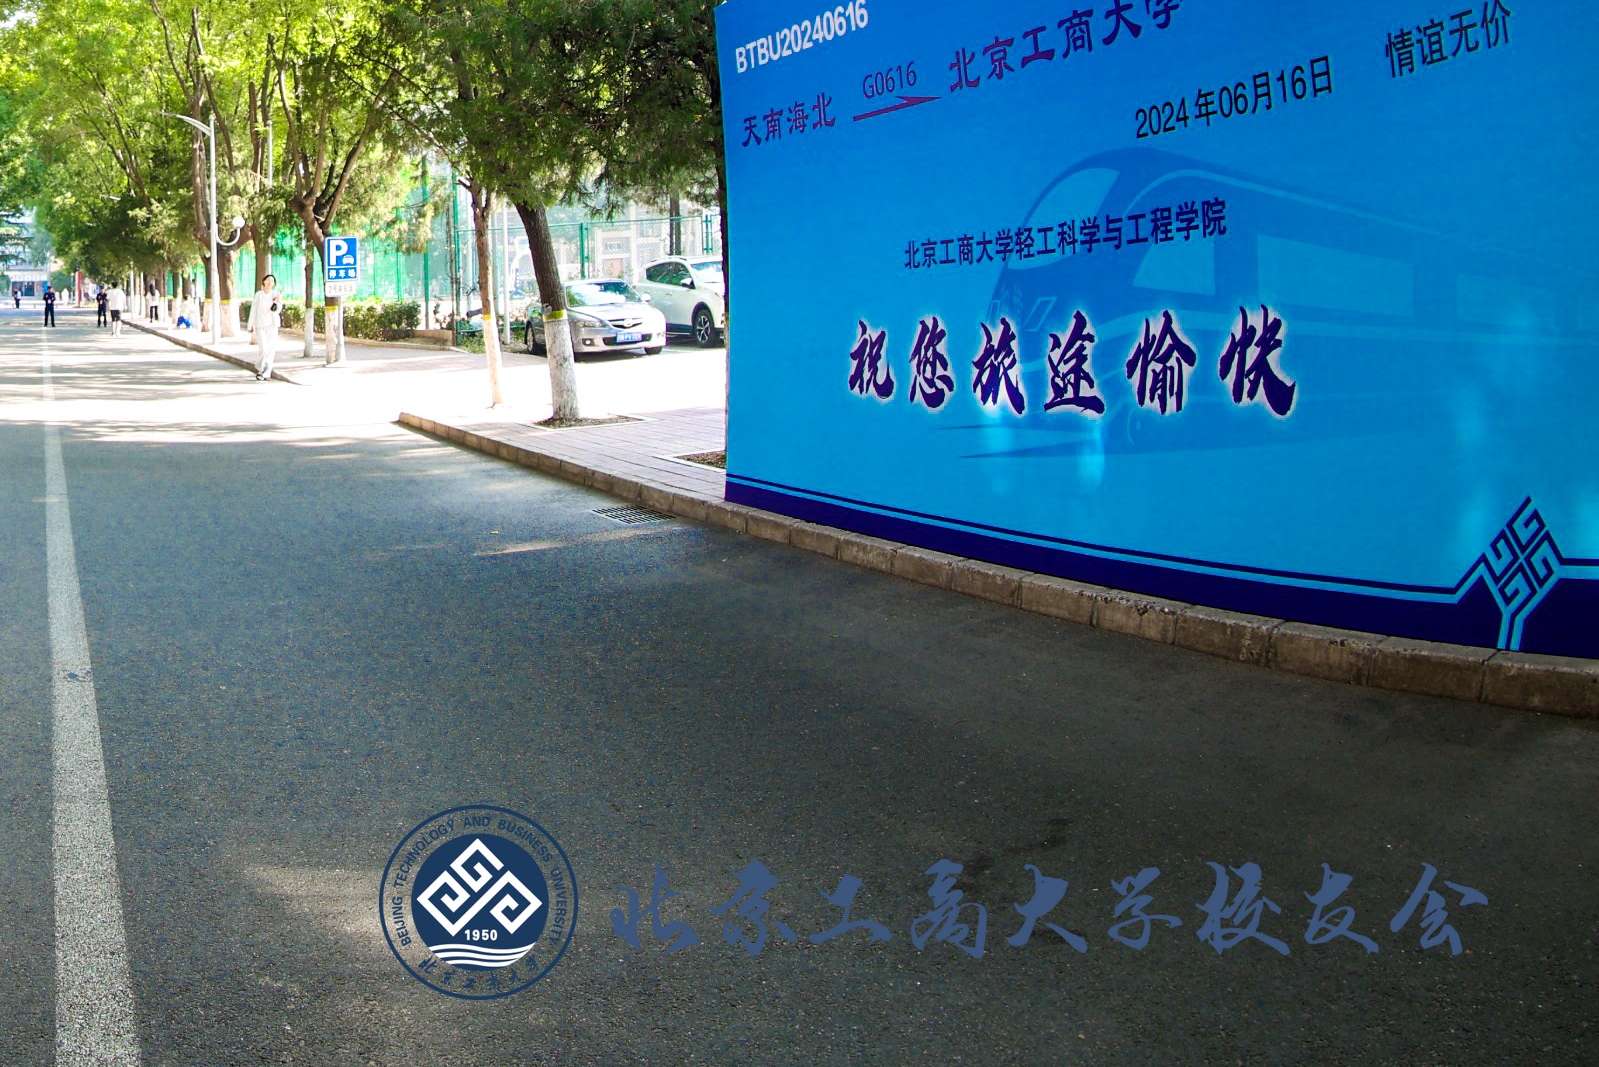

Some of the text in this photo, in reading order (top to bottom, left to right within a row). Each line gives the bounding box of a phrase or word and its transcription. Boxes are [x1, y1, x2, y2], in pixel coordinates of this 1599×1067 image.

[862, 60, 918, 100] G0616
[741, 91, 836, 147] 天南海北
[329, 239, 349, 266] P
[904, 197, 1227, 270] 北京工商大学轻工科学与工程学院
[848, 303, 1297, 417] 祝您旅途愉快
